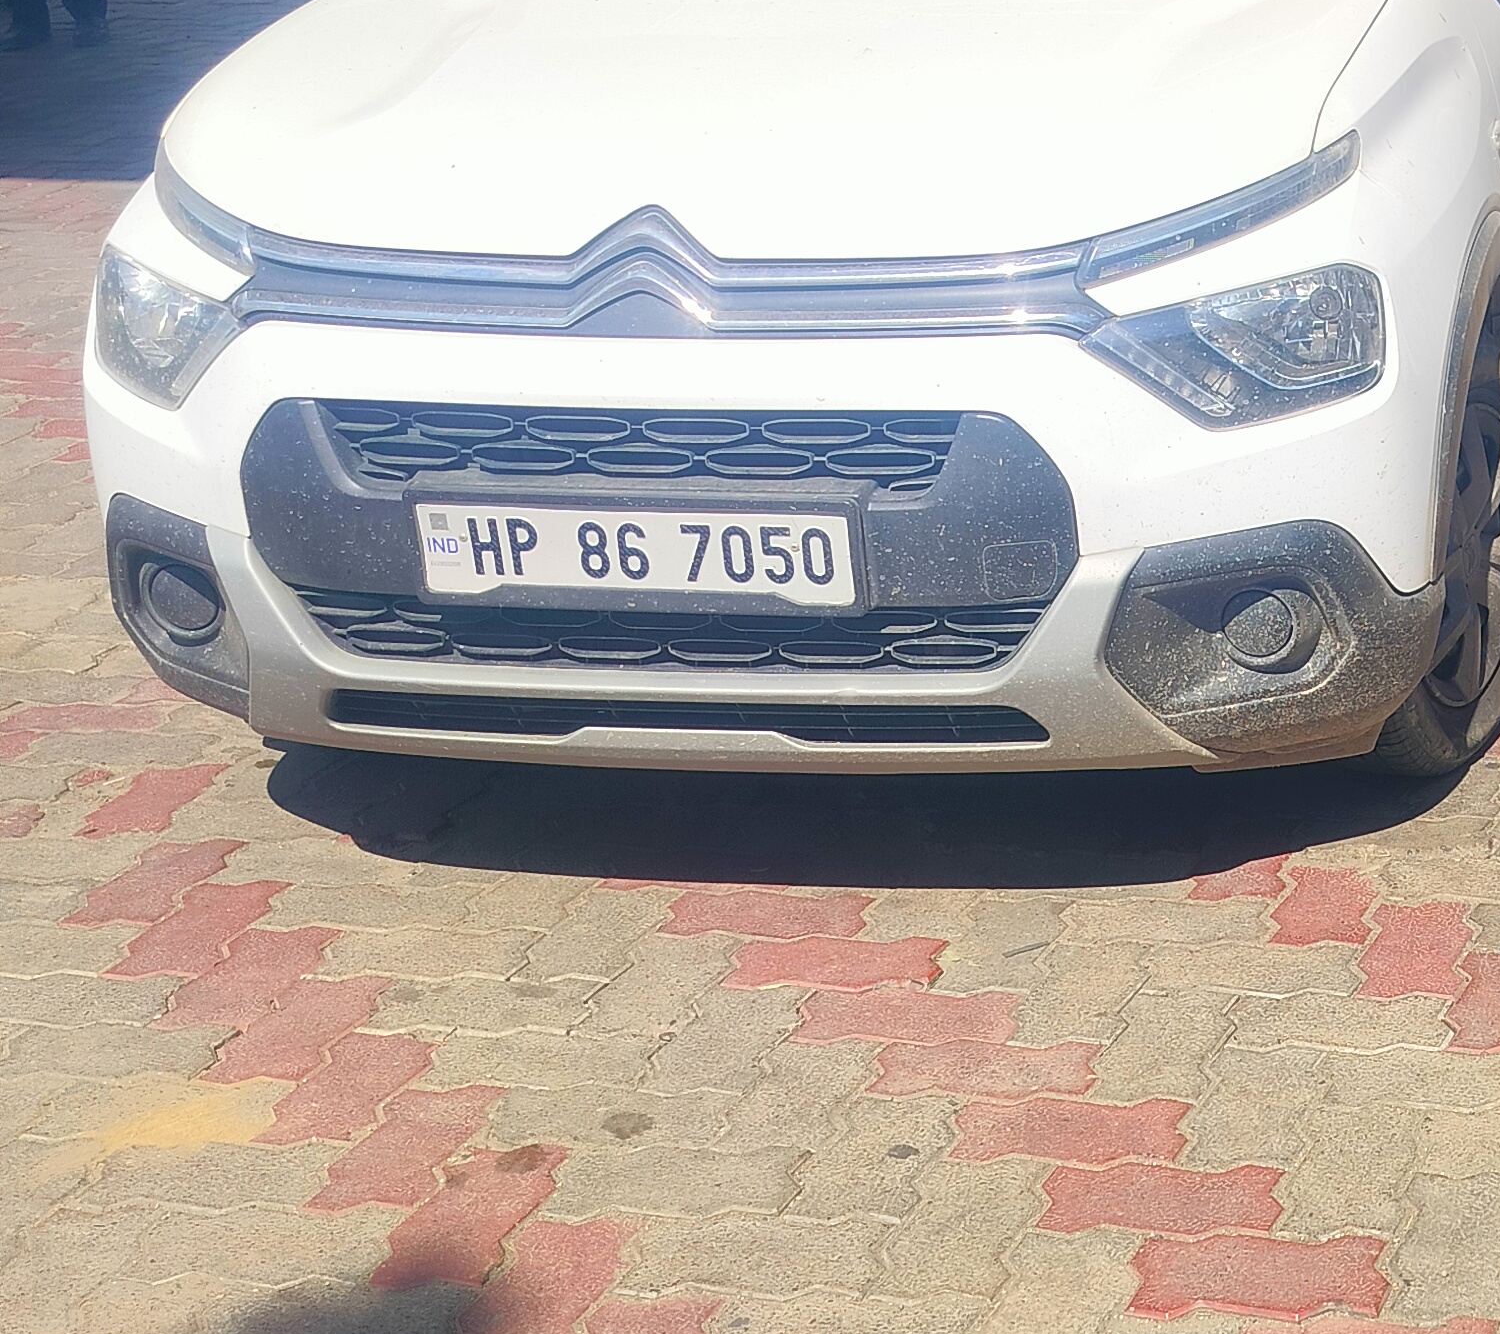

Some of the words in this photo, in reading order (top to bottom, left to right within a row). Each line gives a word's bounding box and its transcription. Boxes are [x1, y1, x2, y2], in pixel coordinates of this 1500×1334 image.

[426, 537, 459, 554] IND
[467, 517, 538, 576] HP
[577, 521, 650, 581] 86
[680, 524, 835, 586] 7050
